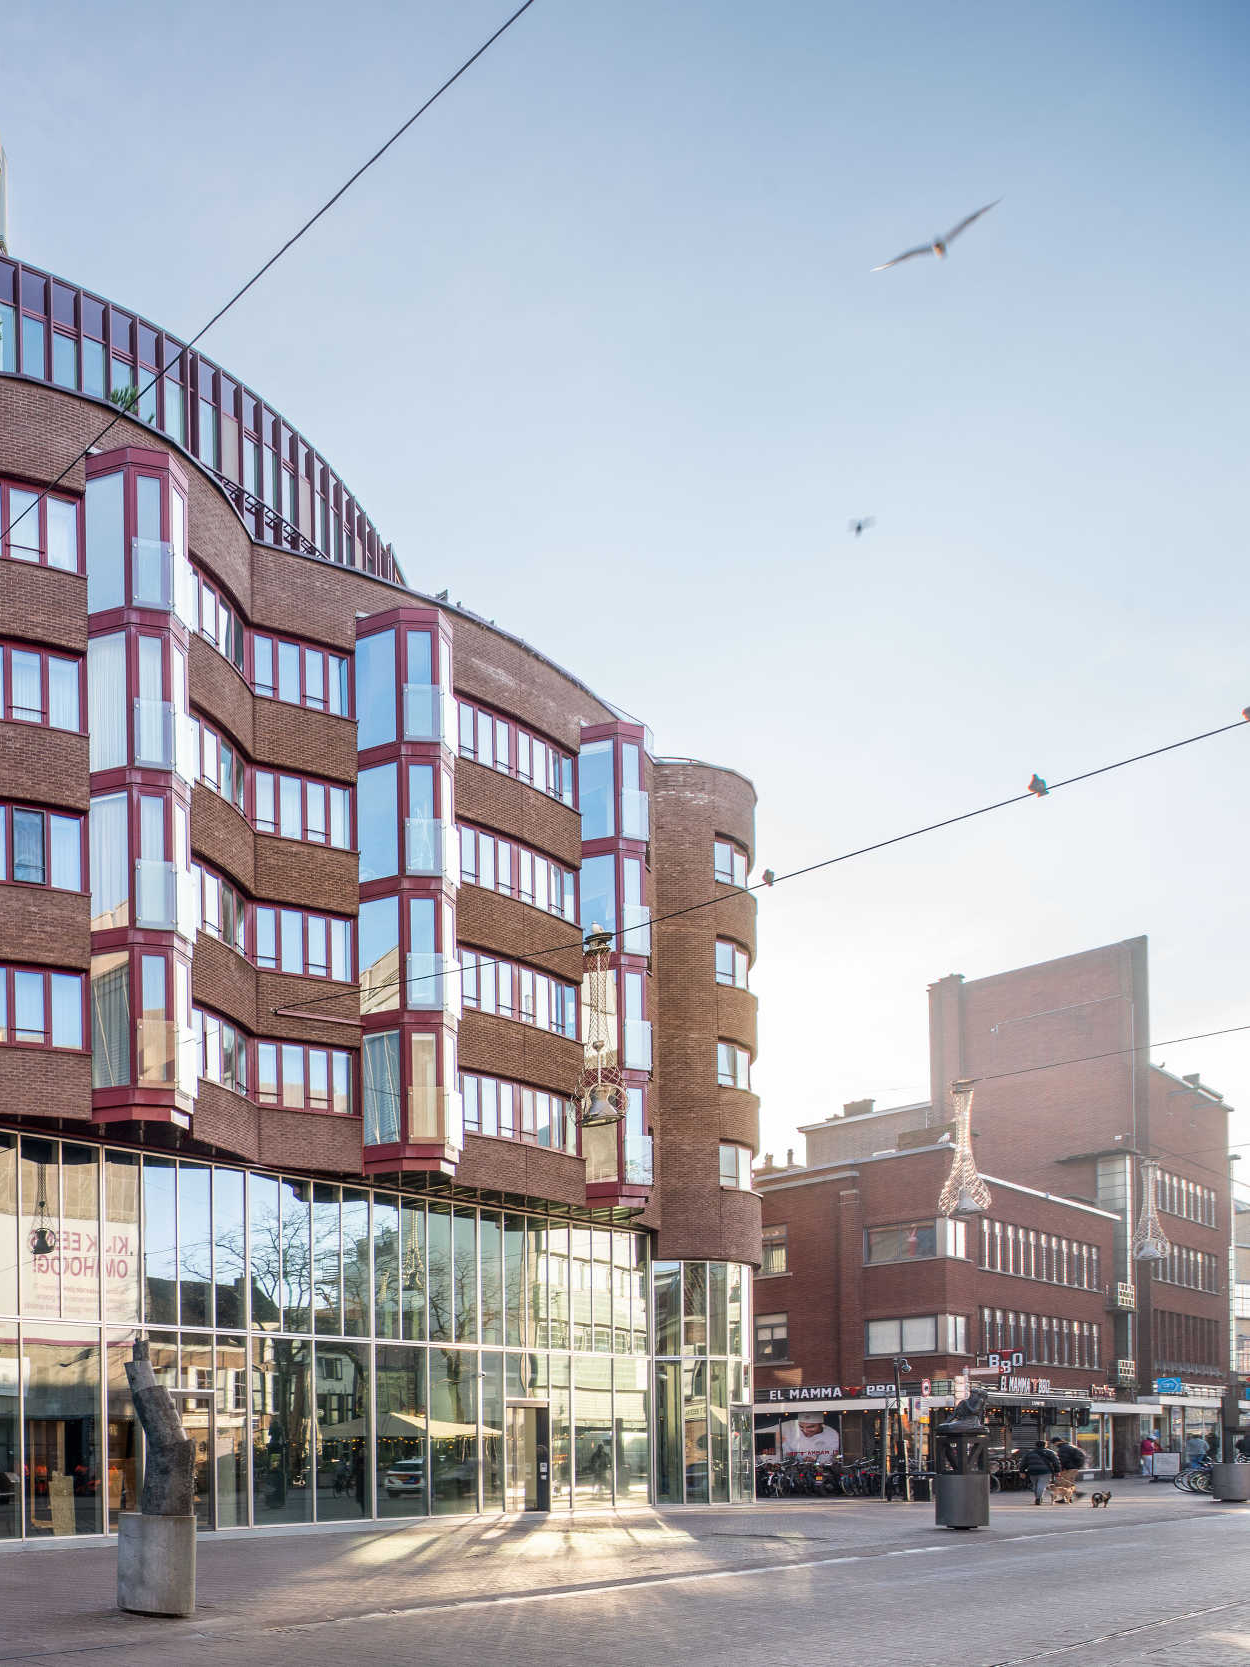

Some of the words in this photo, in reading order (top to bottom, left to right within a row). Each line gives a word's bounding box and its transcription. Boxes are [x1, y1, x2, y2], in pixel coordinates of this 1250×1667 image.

[989, 1352, 1023, 1373] BBQ
[1009, 1377, 1030, 1393] MAMMA
[769, 1390, 785, 1400] EL
[790, 1387, 842, 1399] MAMMA
